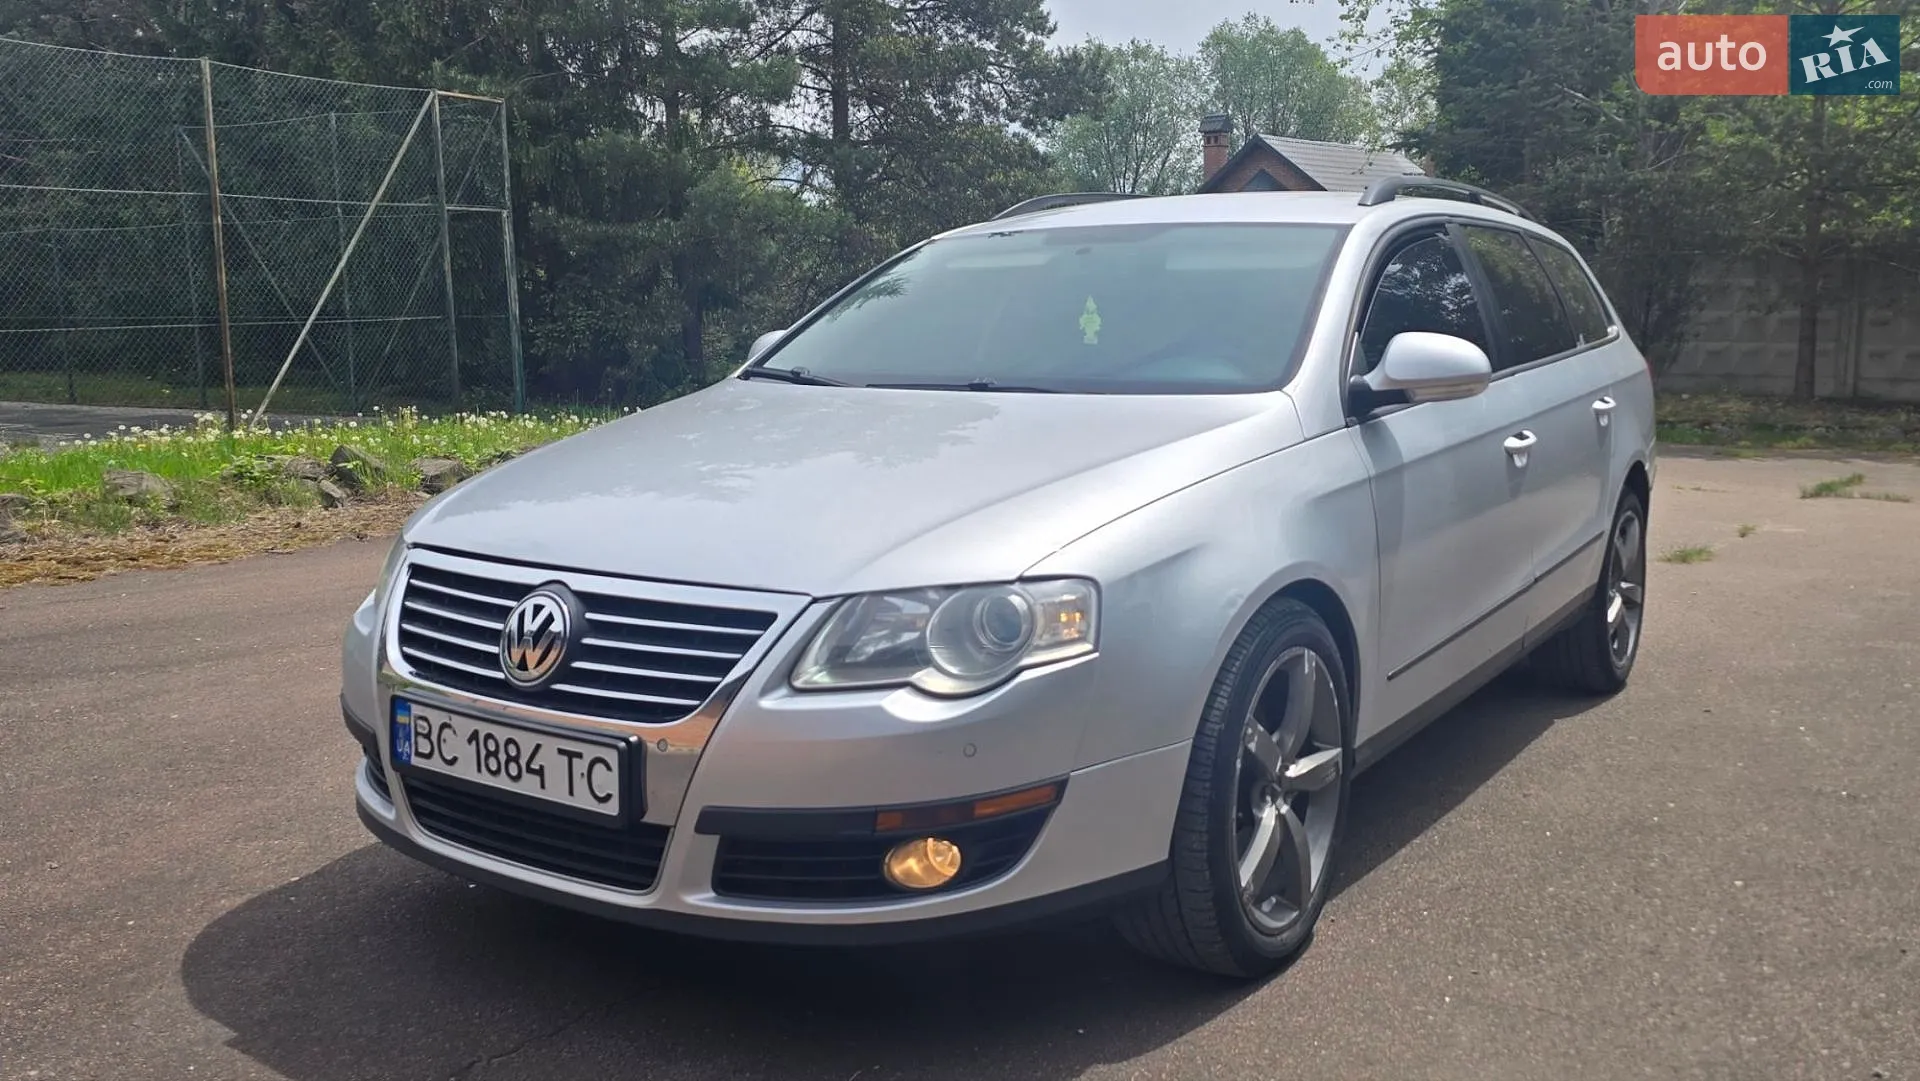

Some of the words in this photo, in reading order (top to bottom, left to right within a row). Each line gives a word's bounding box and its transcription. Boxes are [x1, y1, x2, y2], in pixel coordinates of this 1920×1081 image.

[507, 594, 565, 680] VW
[413, 715, 459, 767] BC
[466, 728, 546, 790] 1884
[557, 746, 613, 804] TC
